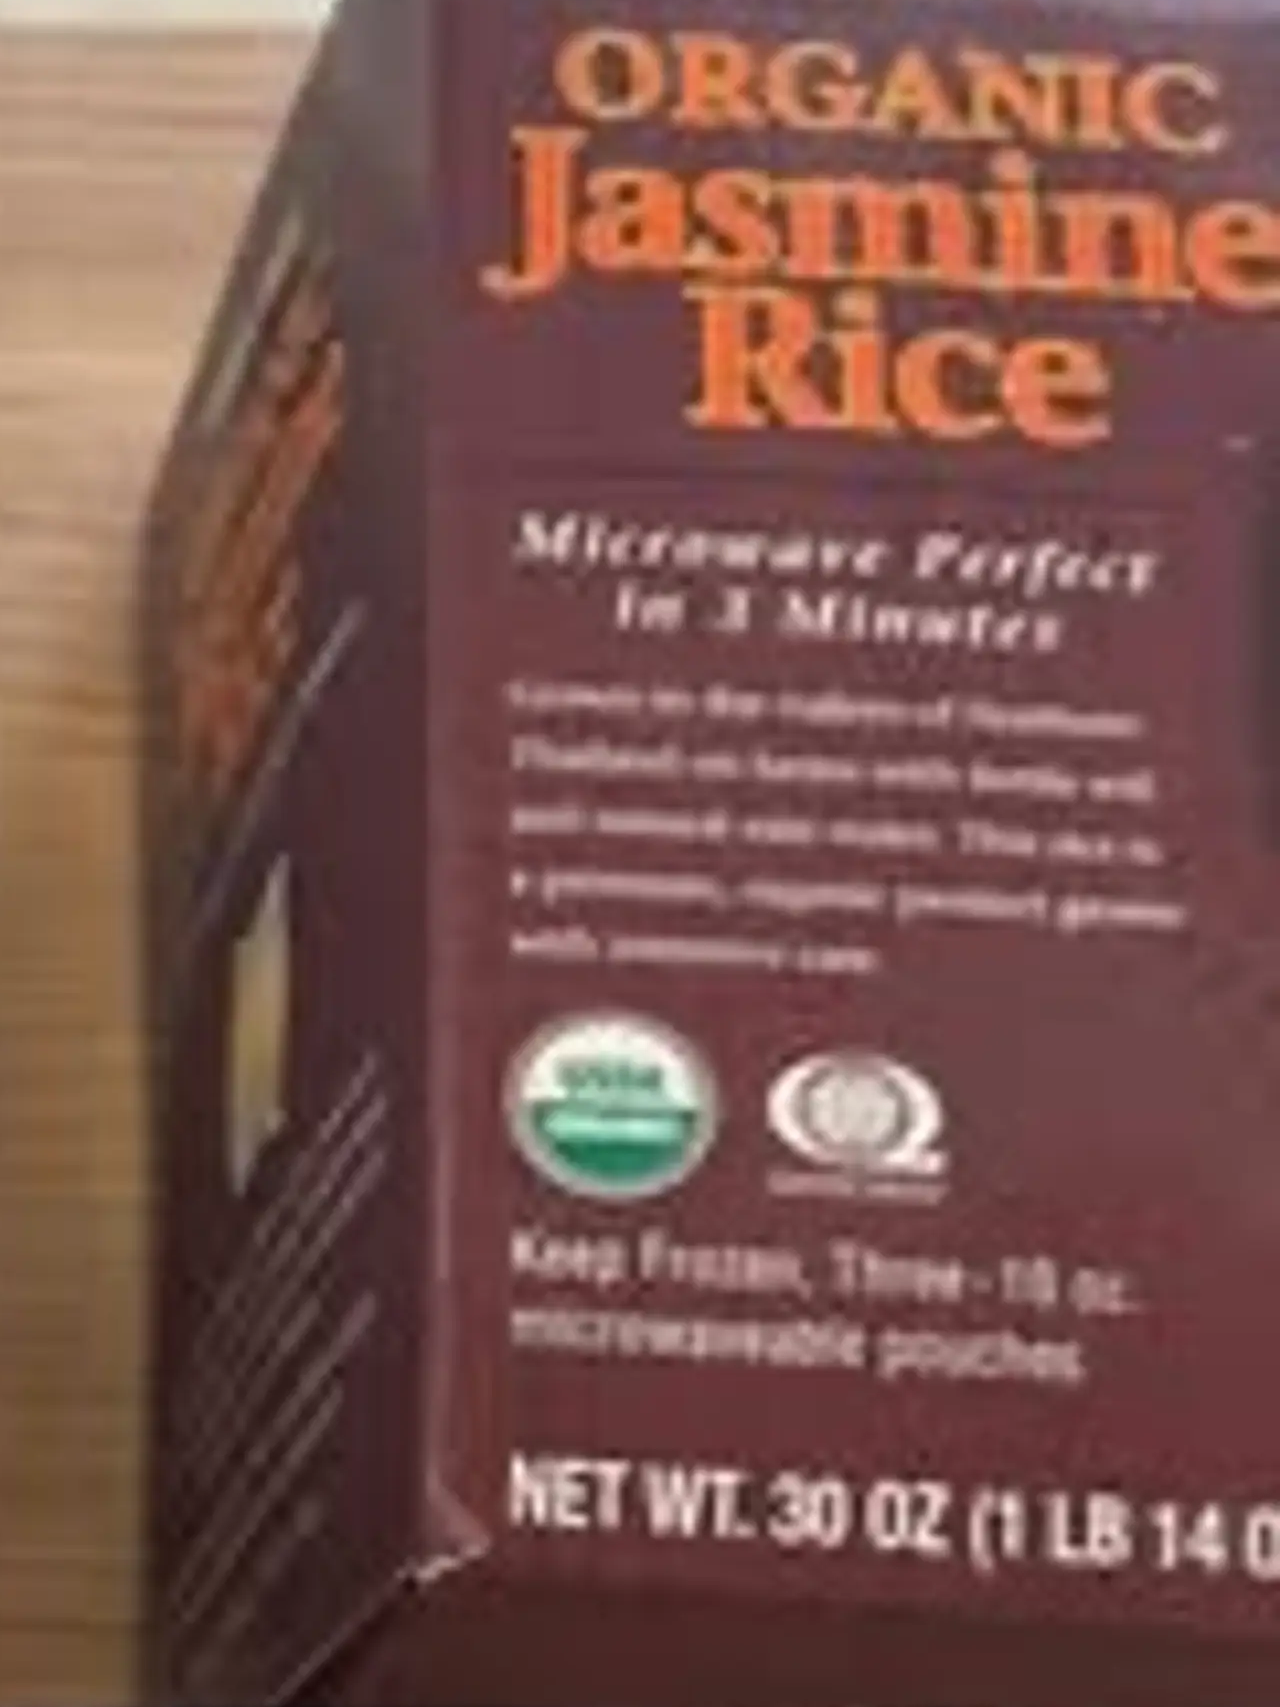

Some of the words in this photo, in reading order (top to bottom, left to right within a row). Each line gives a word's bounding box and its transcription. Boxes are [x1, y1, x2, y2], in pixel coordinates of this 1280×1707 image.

[555, 28, 1227, 154] ORGANIC
[479, 126, 1280, 307] Jasmine
[685, 288, 1110, 445] Rice
[513, 511, 889, 578] Microwave
[916, 531, 1158, 598] Perfect
[617, 578, 683, 630] in
[712, 588, 748, 632] 3
[780, 591, 1060, 651] Minutes
[511, 1228, 625, 1283] Keep
[511, 1305, 863, 1368] microwaveable
[509, 1457, 630, 1528] NET
[646, 1468, 754, 1539] WT.
[770, 1476, 845, 1545] 30
[866, 1484, 950, 1555] OZ
[970, 1491, 1026, 1568] (1
[1055, 1497, 1128, 1565] LB
[1155, 1505, 1226, 1569] 14
